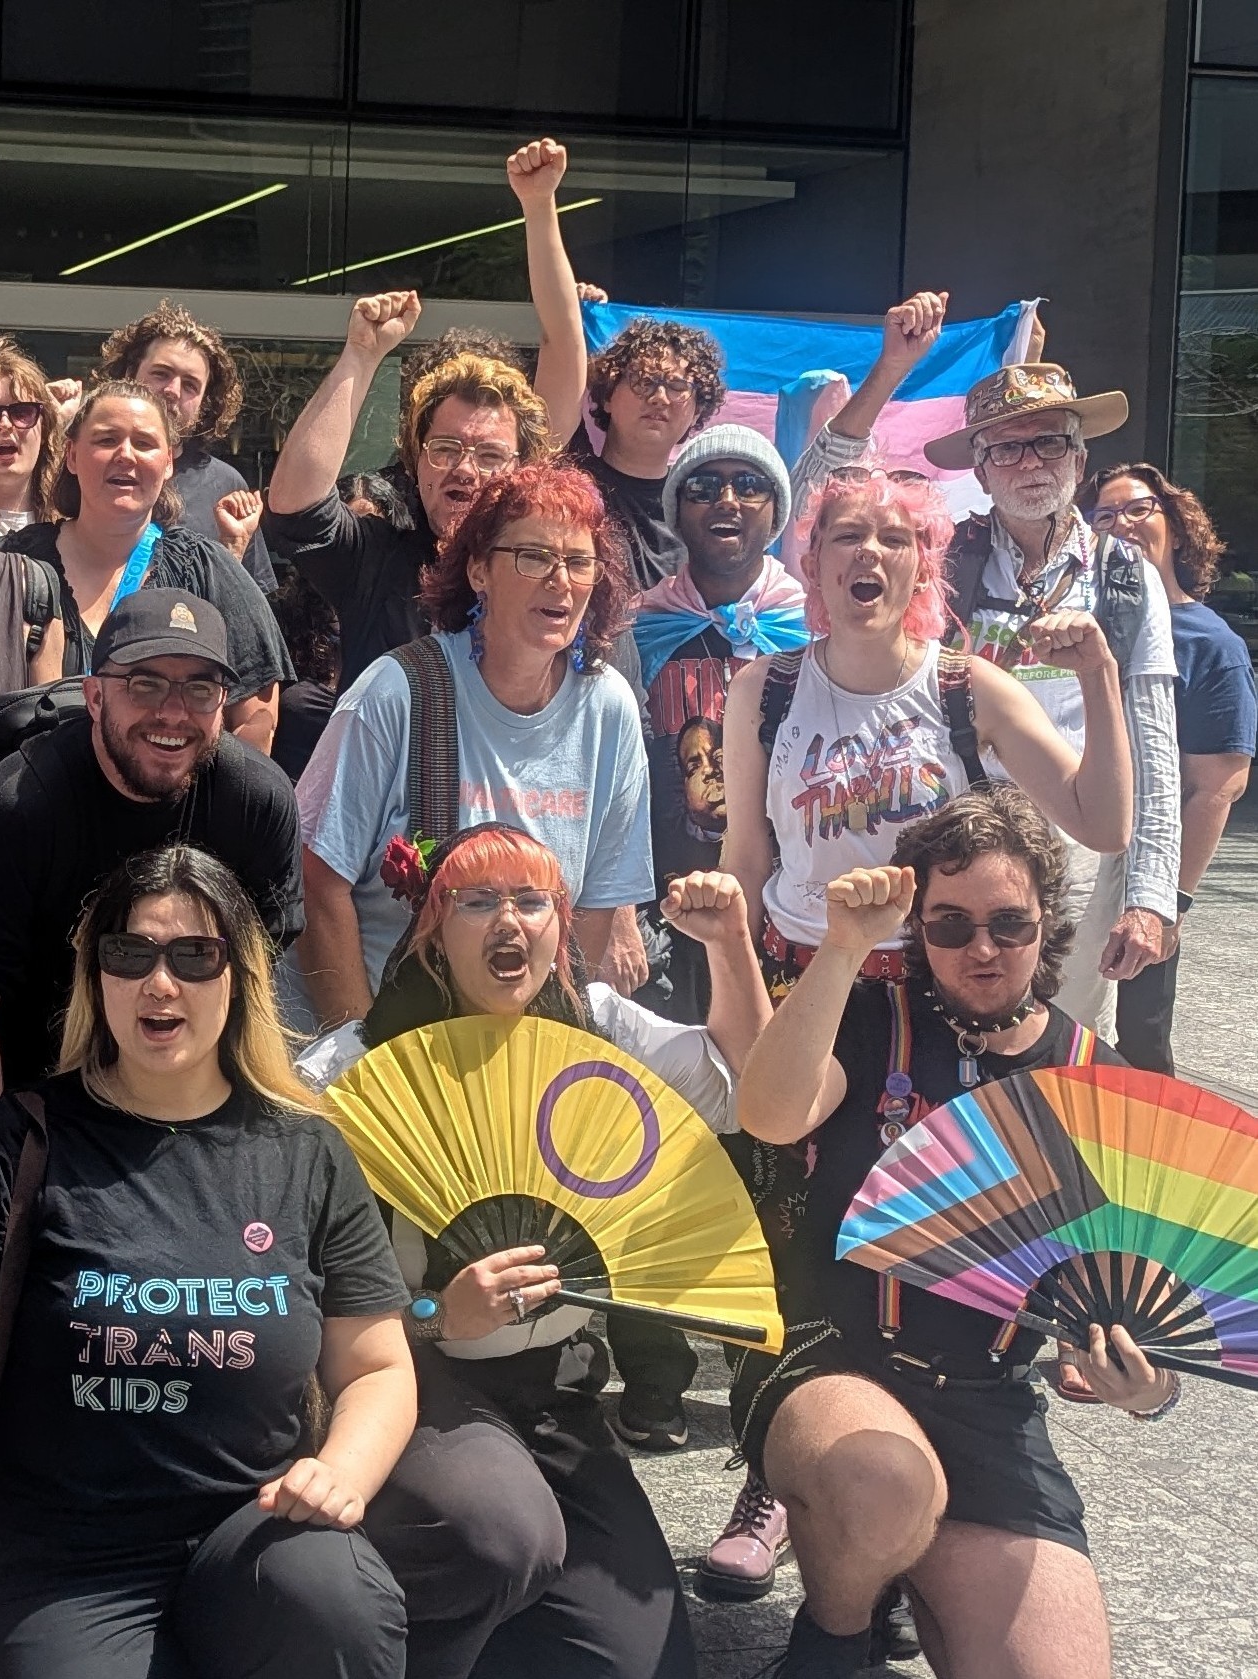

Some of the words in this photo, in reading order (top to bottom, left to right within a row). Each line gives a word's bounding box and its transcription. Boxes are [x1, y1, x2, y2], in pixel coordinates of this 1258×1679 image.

[800, 715, 922, 789] LOVE
[792, 763, 950, 848] THRILLS
[73, 1271, 290, 1316] PROTECT
[70, 1321, 256, 1369] TRANS
[72, 1374, 192, 1413] KIDS
